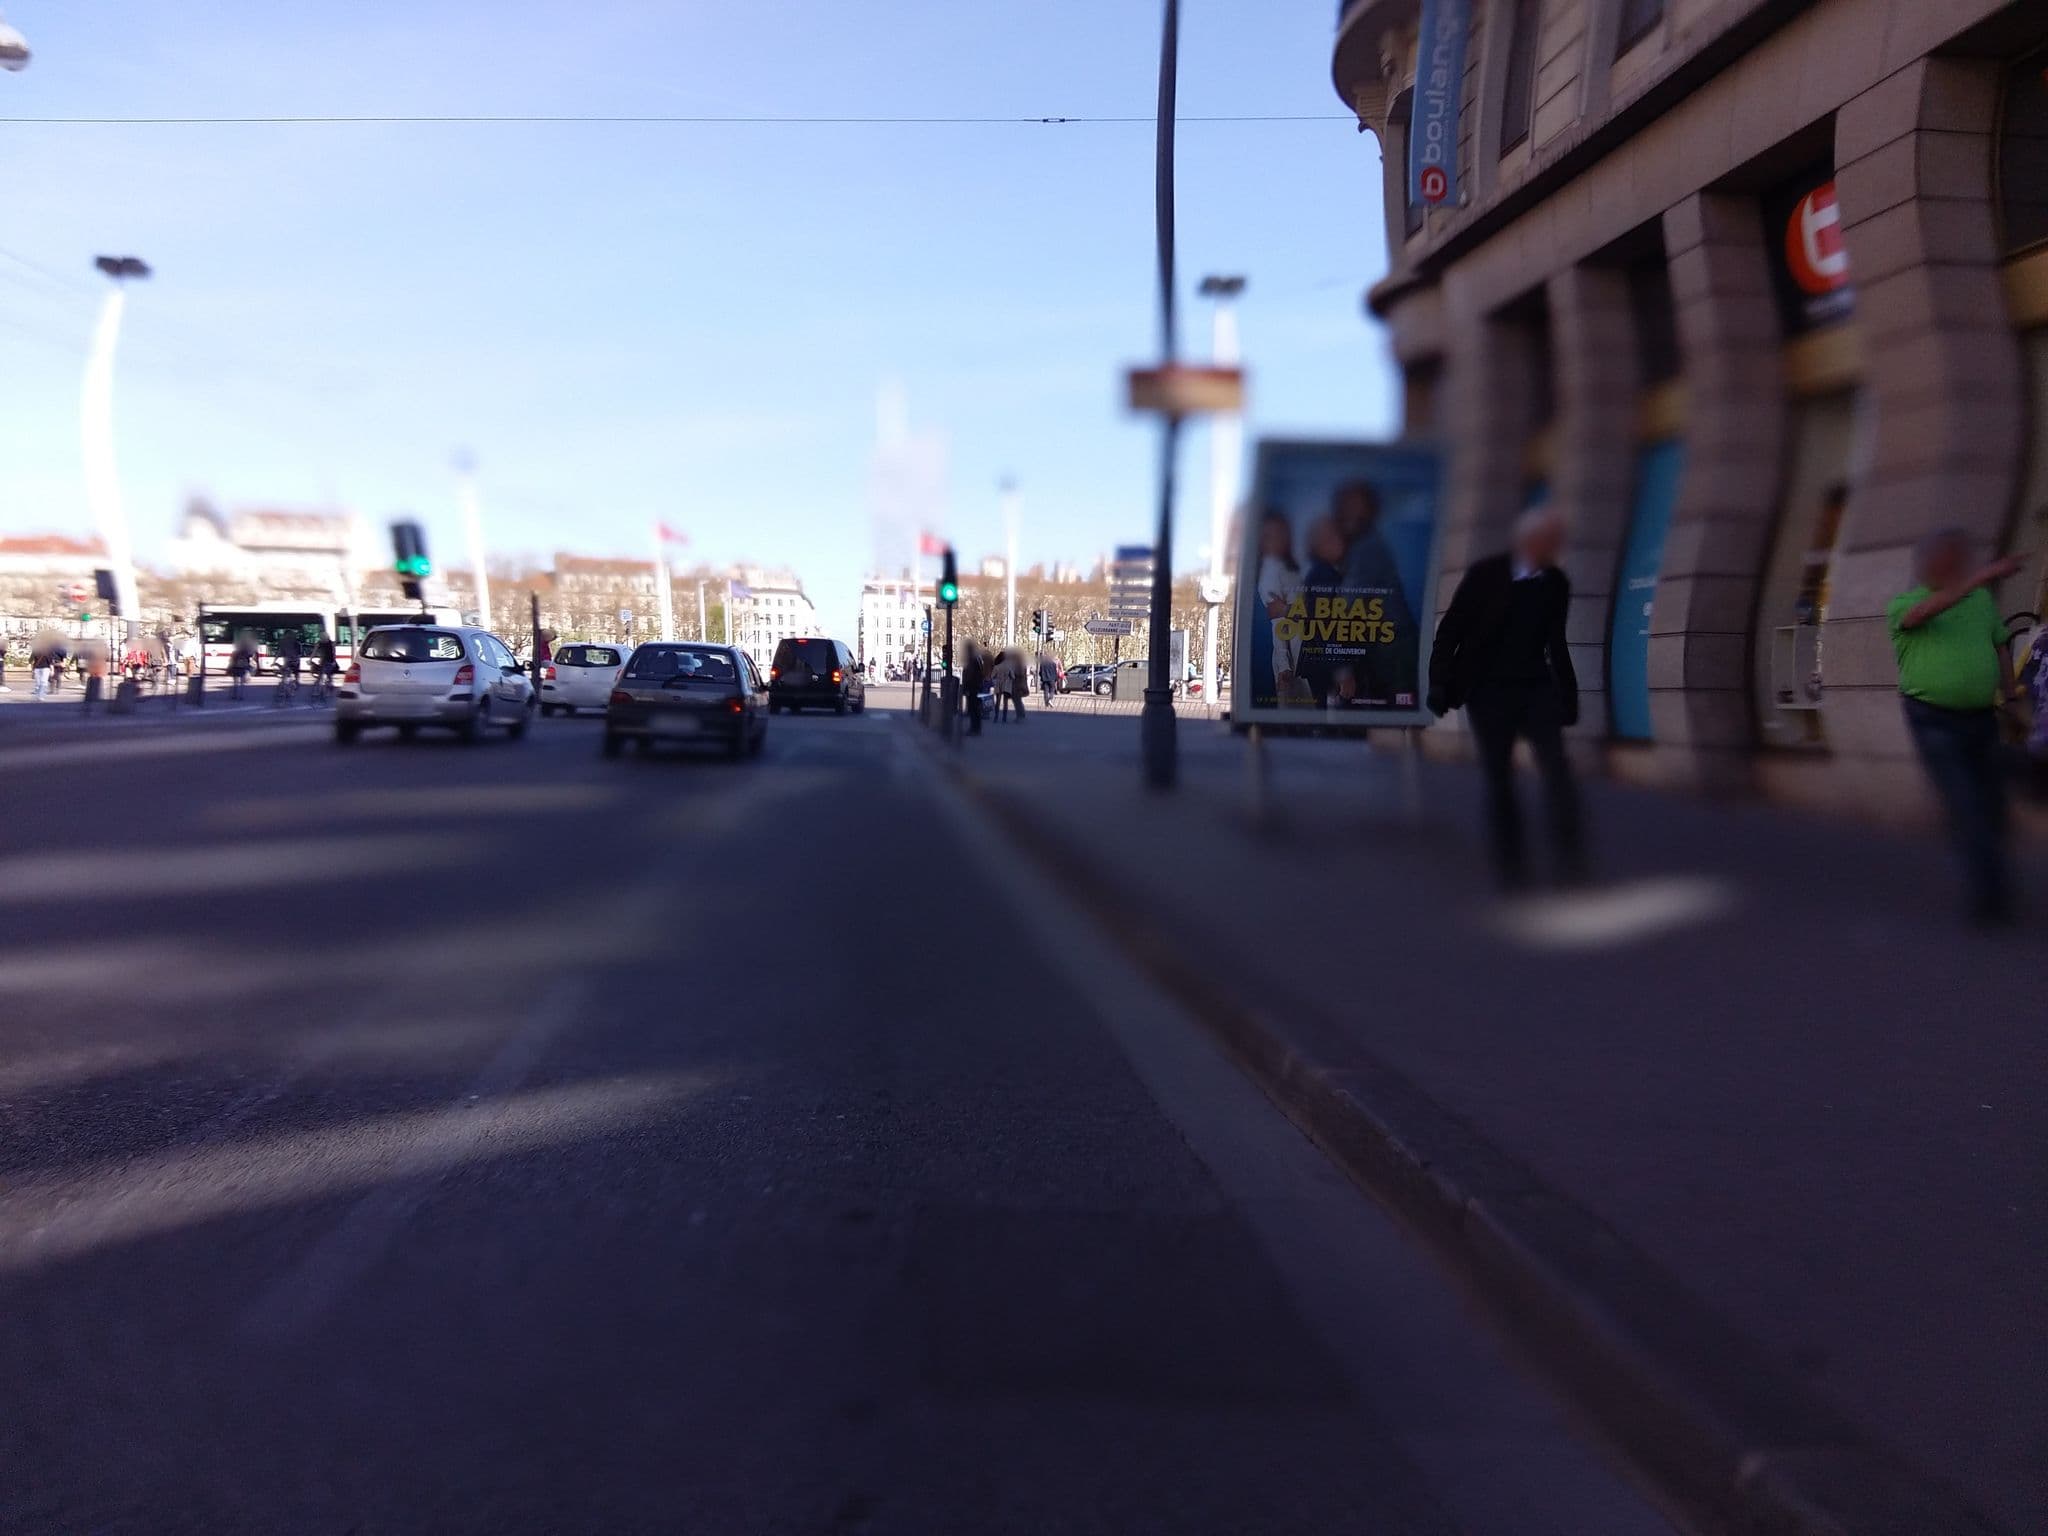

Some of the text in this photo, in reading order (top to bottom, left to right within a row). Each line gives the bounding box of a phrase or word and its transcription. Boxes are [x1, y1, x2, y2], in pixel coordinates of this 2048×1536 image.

[1310, 585, 1332, 593] POUR
[1314, 597, 1384, 620] BRAS
[1275, 619, 1395, 643] OUVERTS
[1325, 647, 1332, 655] DE
